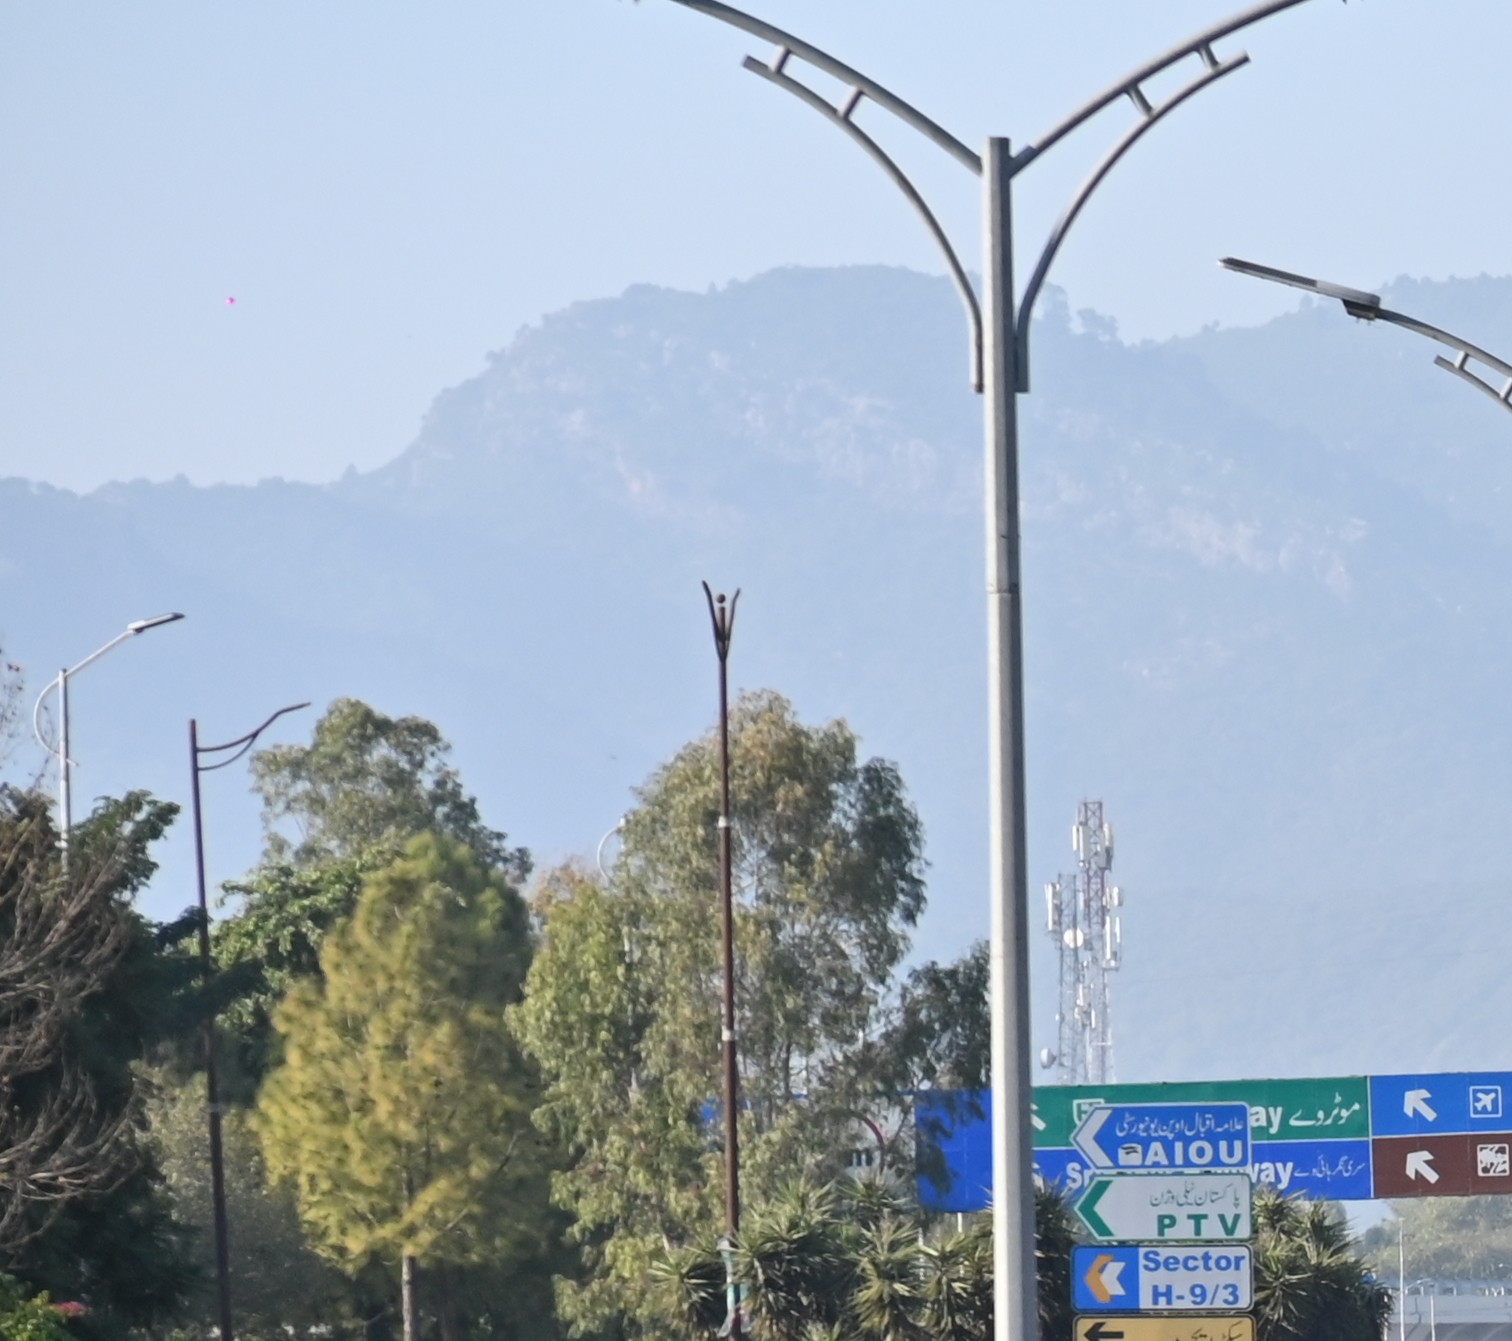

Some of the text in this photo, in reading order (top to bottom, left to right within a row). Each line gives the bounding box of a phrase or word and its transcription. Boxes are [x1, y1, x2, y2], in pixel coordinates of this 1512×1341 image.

[1288, 1091, 1361, 1126] موٹروے
[1184, 1111, 1215, 1137] اقبال
[1144, 1140, 1243, 1166] AIOU
[1194, 1183, 1240, 1209] پاکستان
[1142, 1250, 1246, 1272] Sector
[1151, 1283, 1240, 1306] H-9/3
